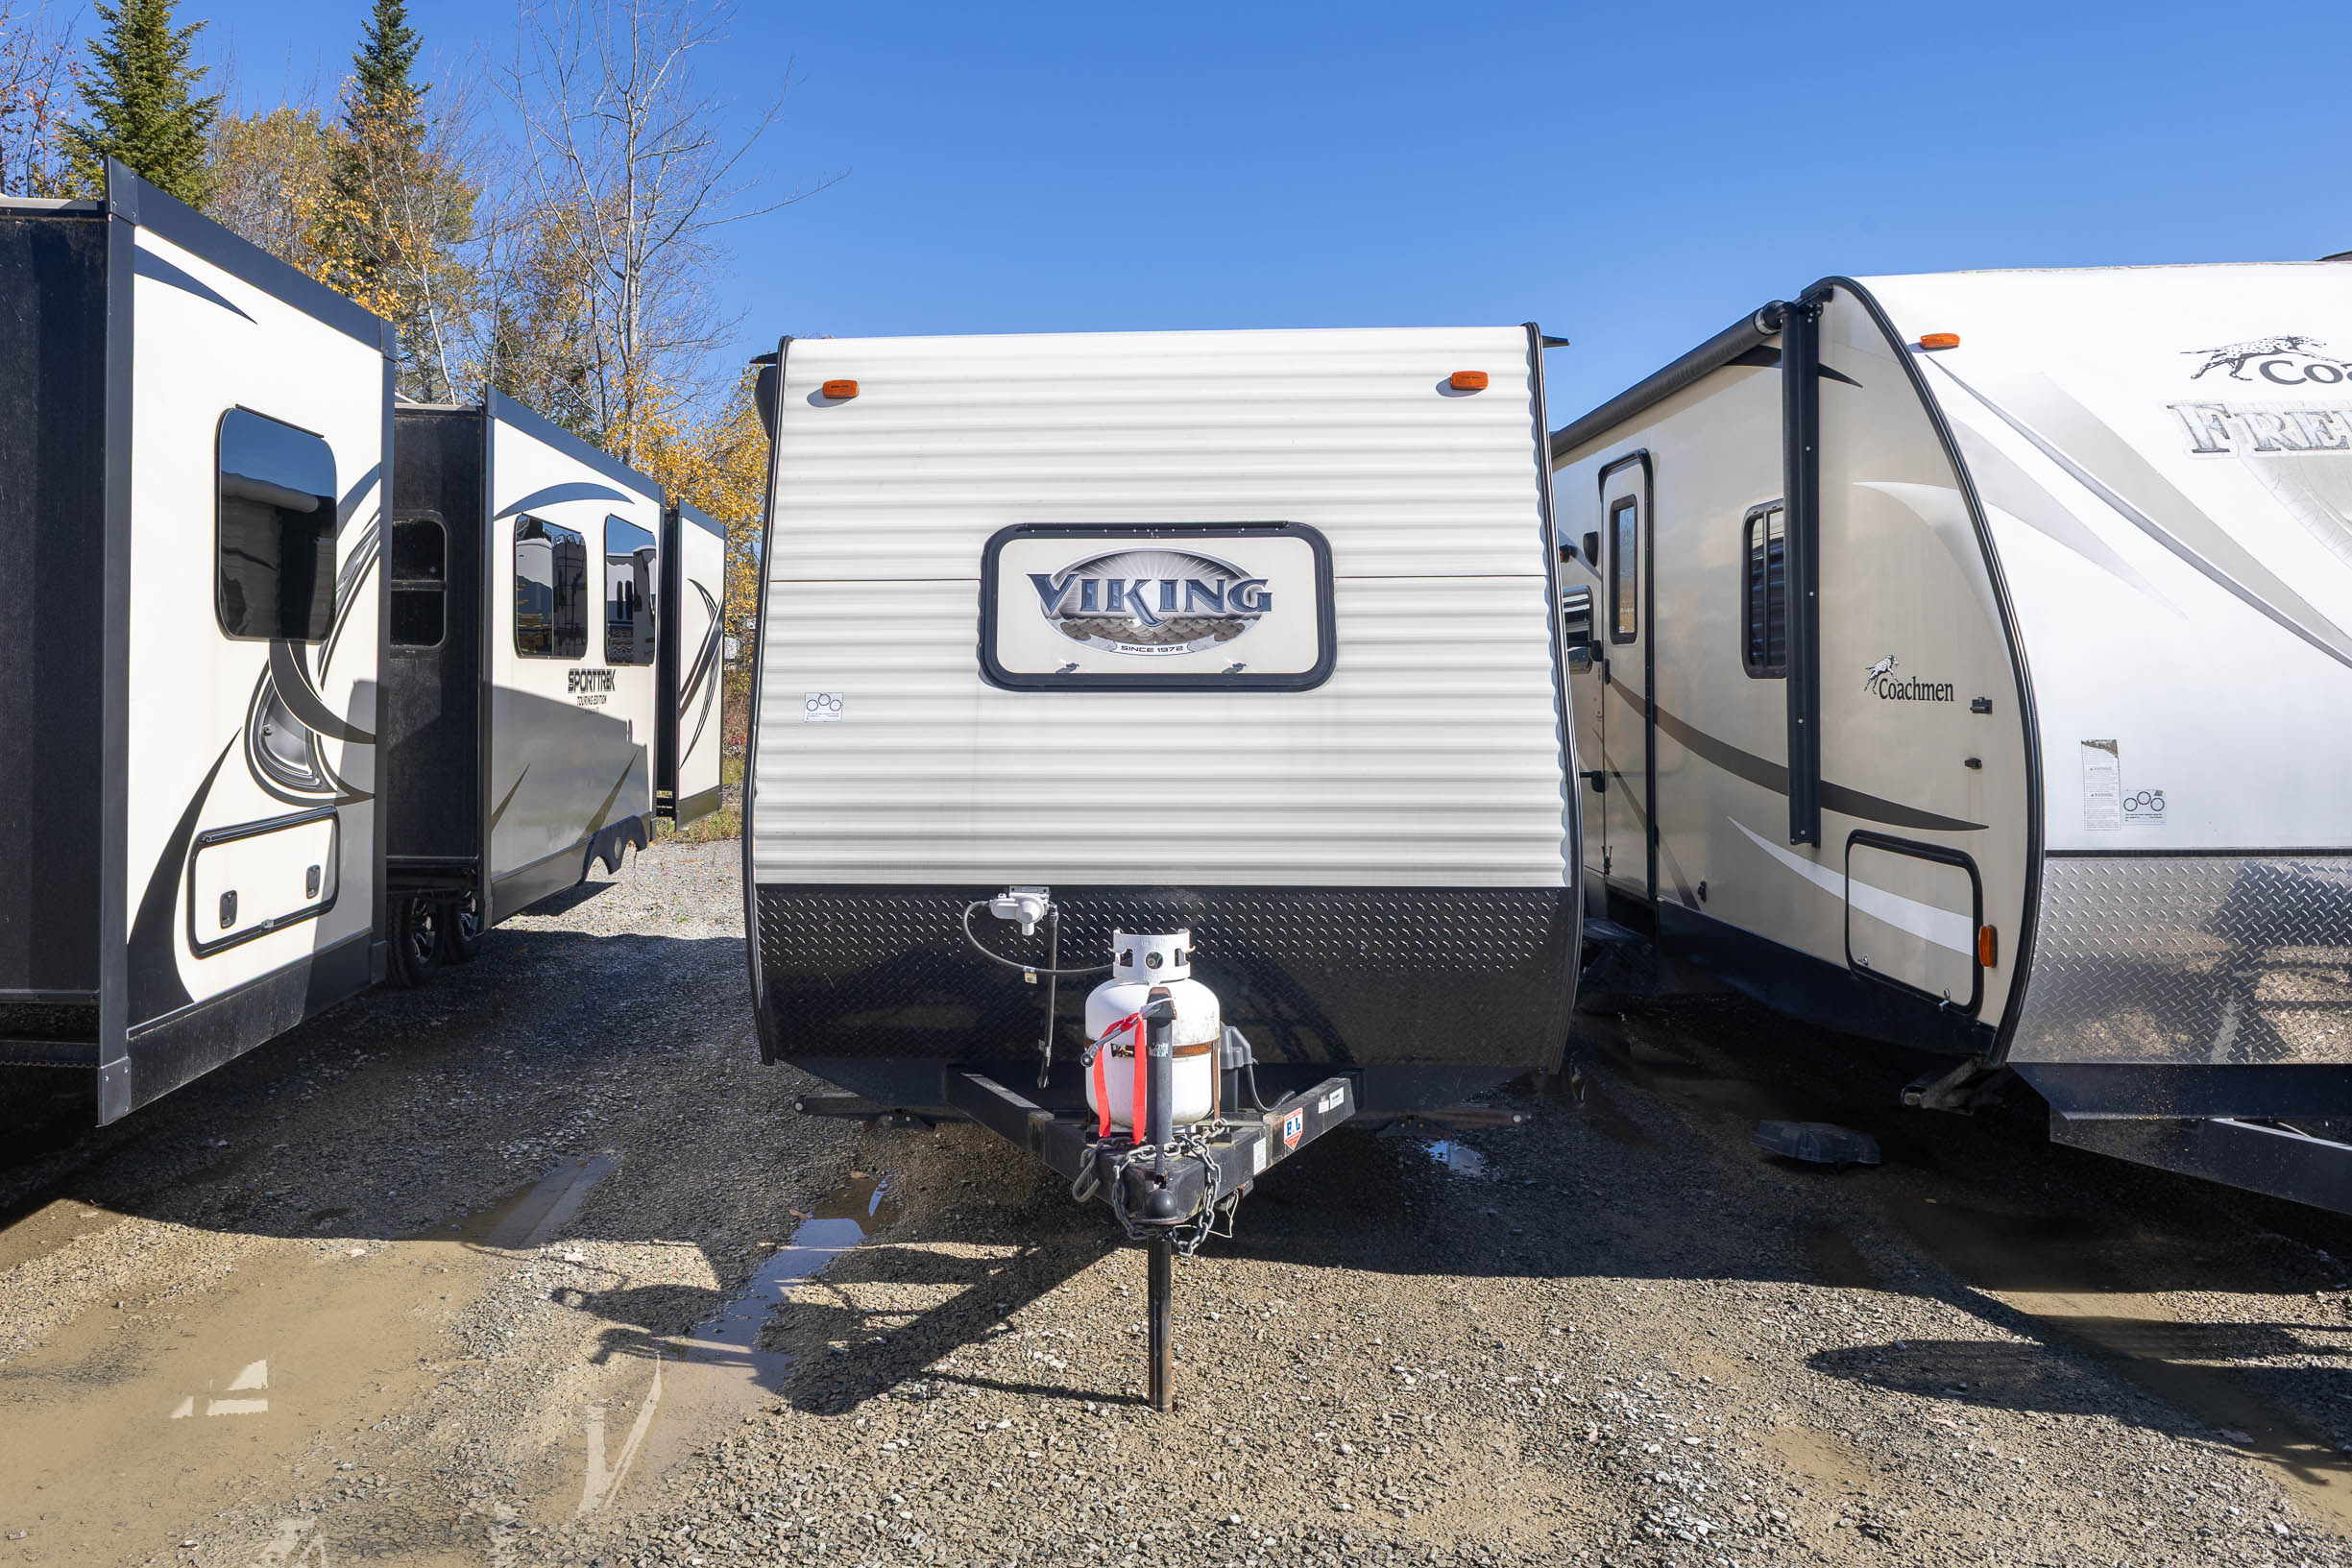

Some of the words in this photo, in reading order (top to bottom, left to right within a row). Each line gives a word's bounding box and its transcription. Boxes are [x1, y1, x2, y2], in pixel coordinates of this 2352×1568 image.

[1025, 573, 1273, 628] VIKING
[1121, 644, 1154, 653] SINCE
[569, 668, 617, 693] SPORTTREK
[1879, 676, 1955, 701] Coachmen
